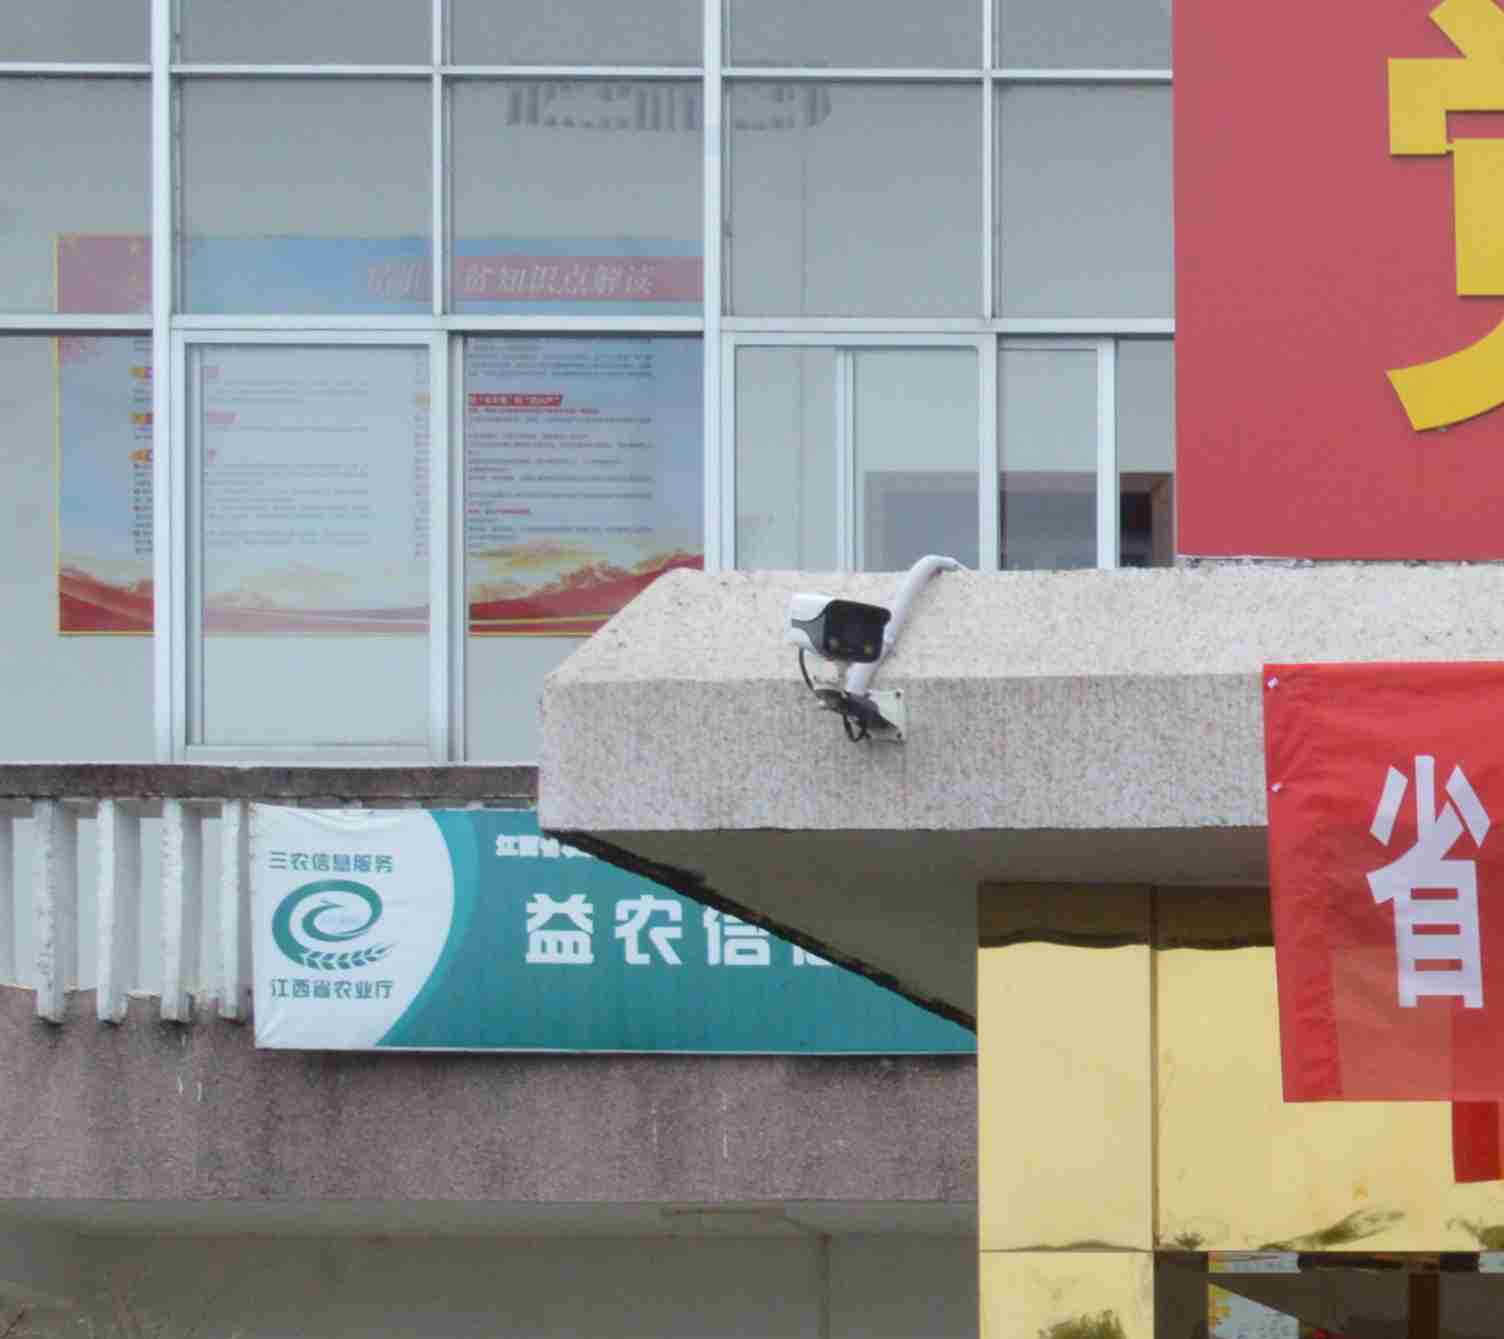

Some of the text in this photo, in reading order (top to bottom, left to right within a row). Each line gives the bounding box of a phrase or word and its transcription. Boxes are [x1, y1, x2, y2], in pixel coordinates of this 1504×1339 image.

[270, 850, 393, 874] 三农信息服务
[271, 978, 393, 1000] 江西省农业厅
